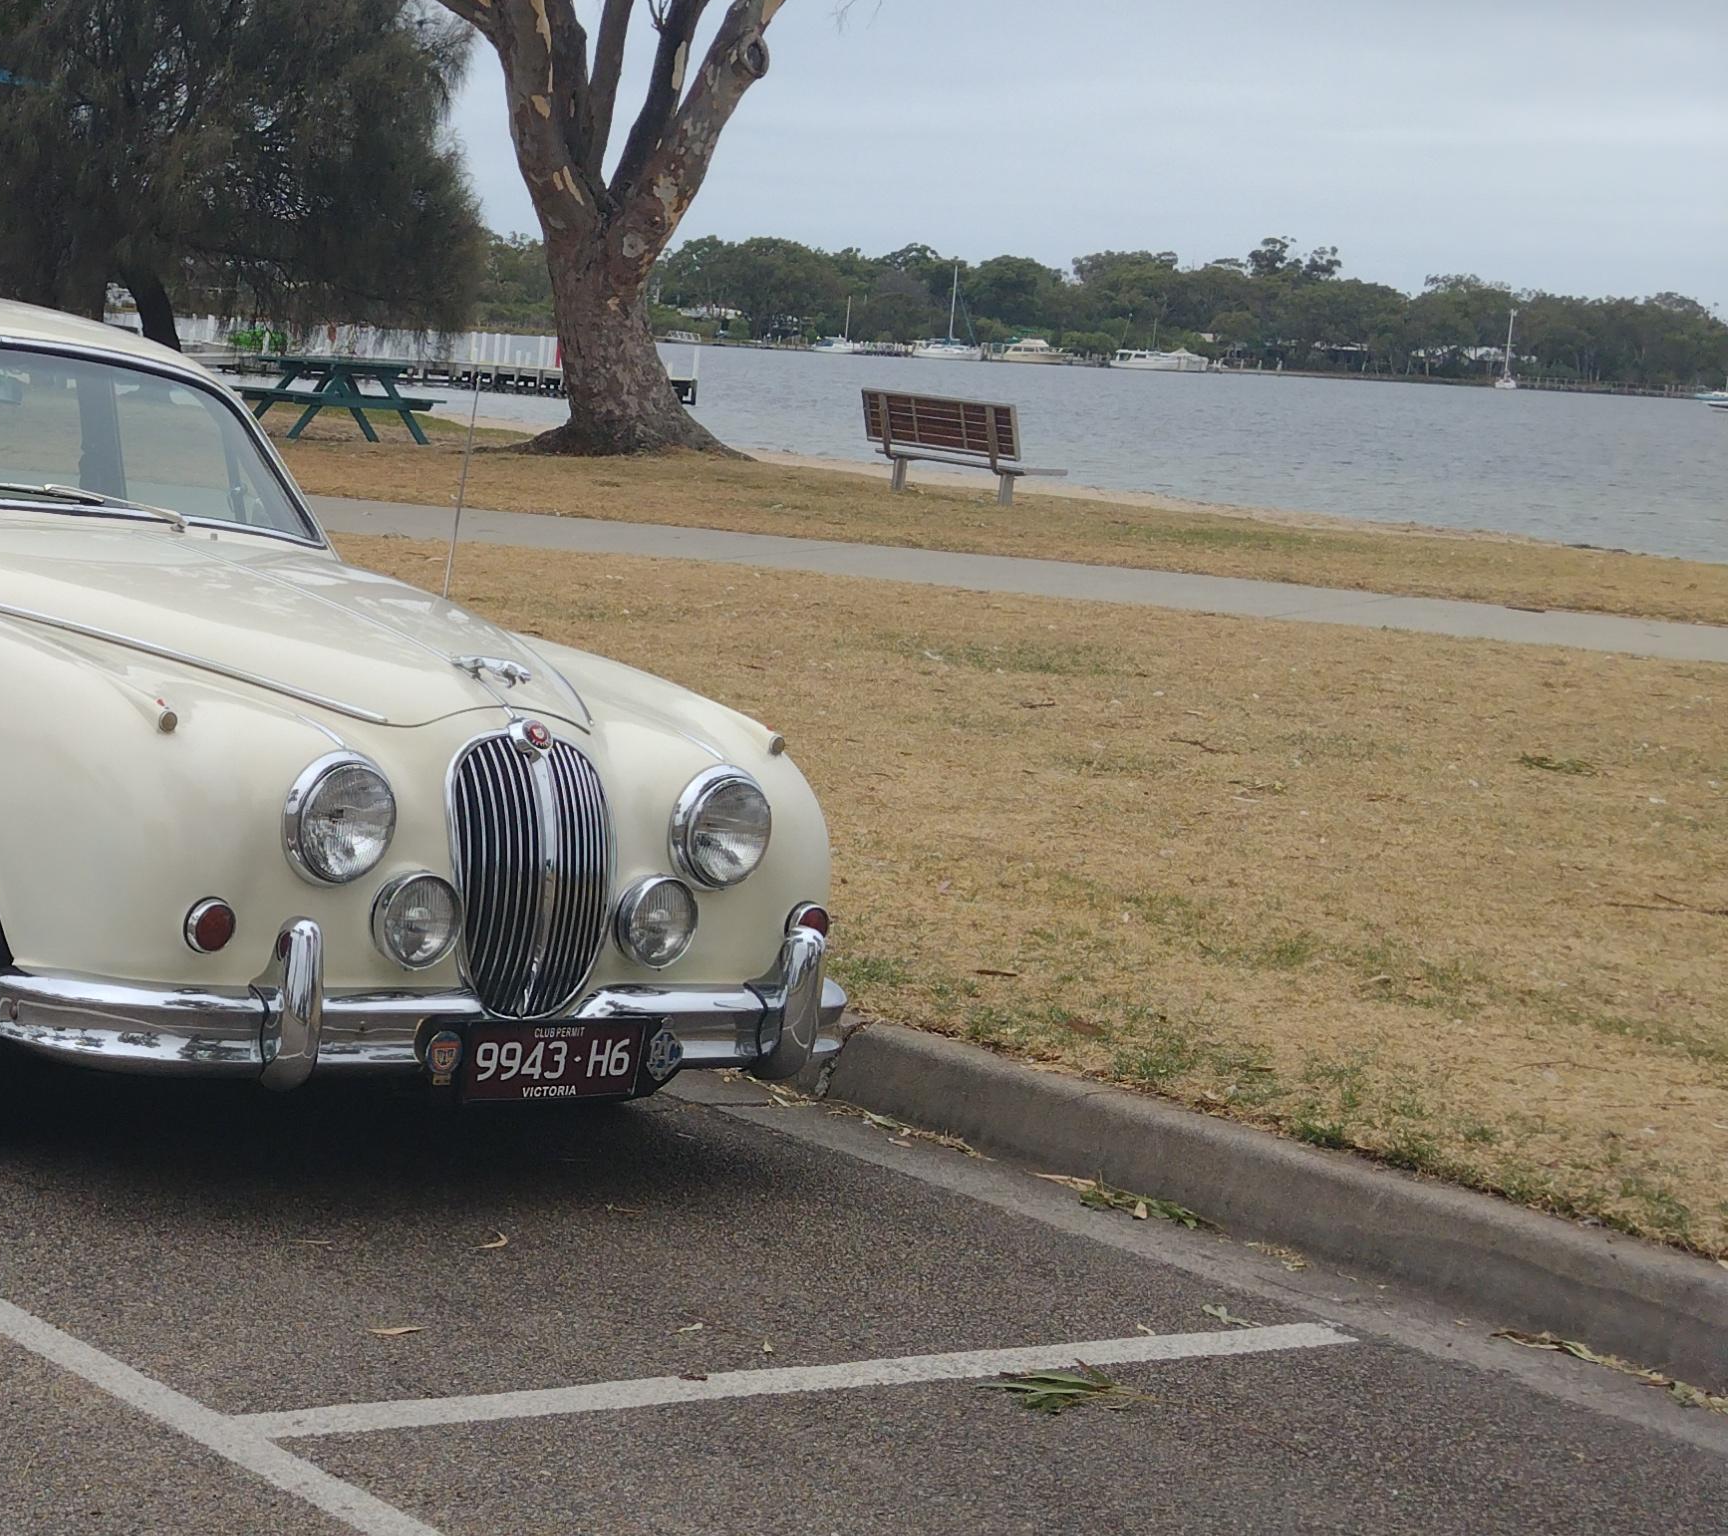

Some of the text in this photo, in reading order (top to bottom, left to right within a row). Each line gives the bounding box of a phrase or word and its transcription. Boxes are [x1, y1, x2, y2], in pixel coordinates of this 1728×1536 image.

[534, 1026, 586, 1038] CLUB PERMIT
[476, 1040, 568, 1081] 9943
[522, 1085, 577, 1098] VICTORIA
